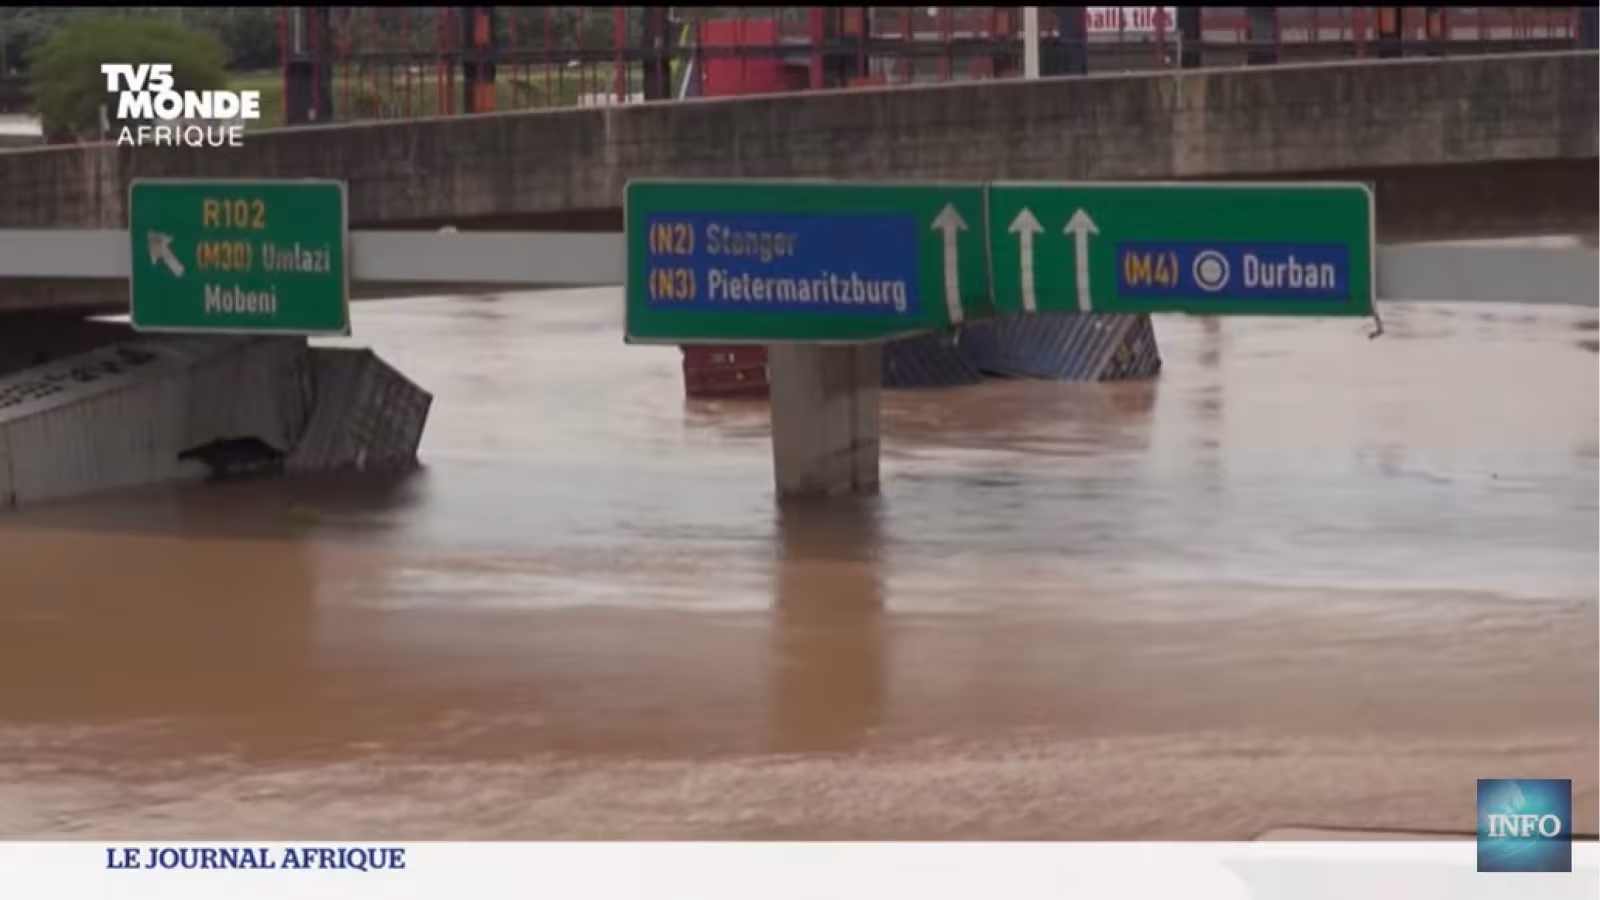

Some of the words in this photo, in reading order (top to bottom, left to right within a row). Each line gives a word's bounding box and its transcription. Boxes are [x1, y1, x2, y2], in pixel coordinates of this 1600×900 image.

[203, 199, 266, 229] R102
[650, 224, 695, 255] (N2)
[196, 241, 252, 272] (M30)
[261, 243, 330, 272] Umlazi
[1124, 252, 1179, 284] (M4)
[1242, 255, 1336, 289] Durban
[204, 284, 277, 314] Mobeni
[650, 268, 696, 300] (N3)
[707, 269, 907, 312] Pietermaritzburg
